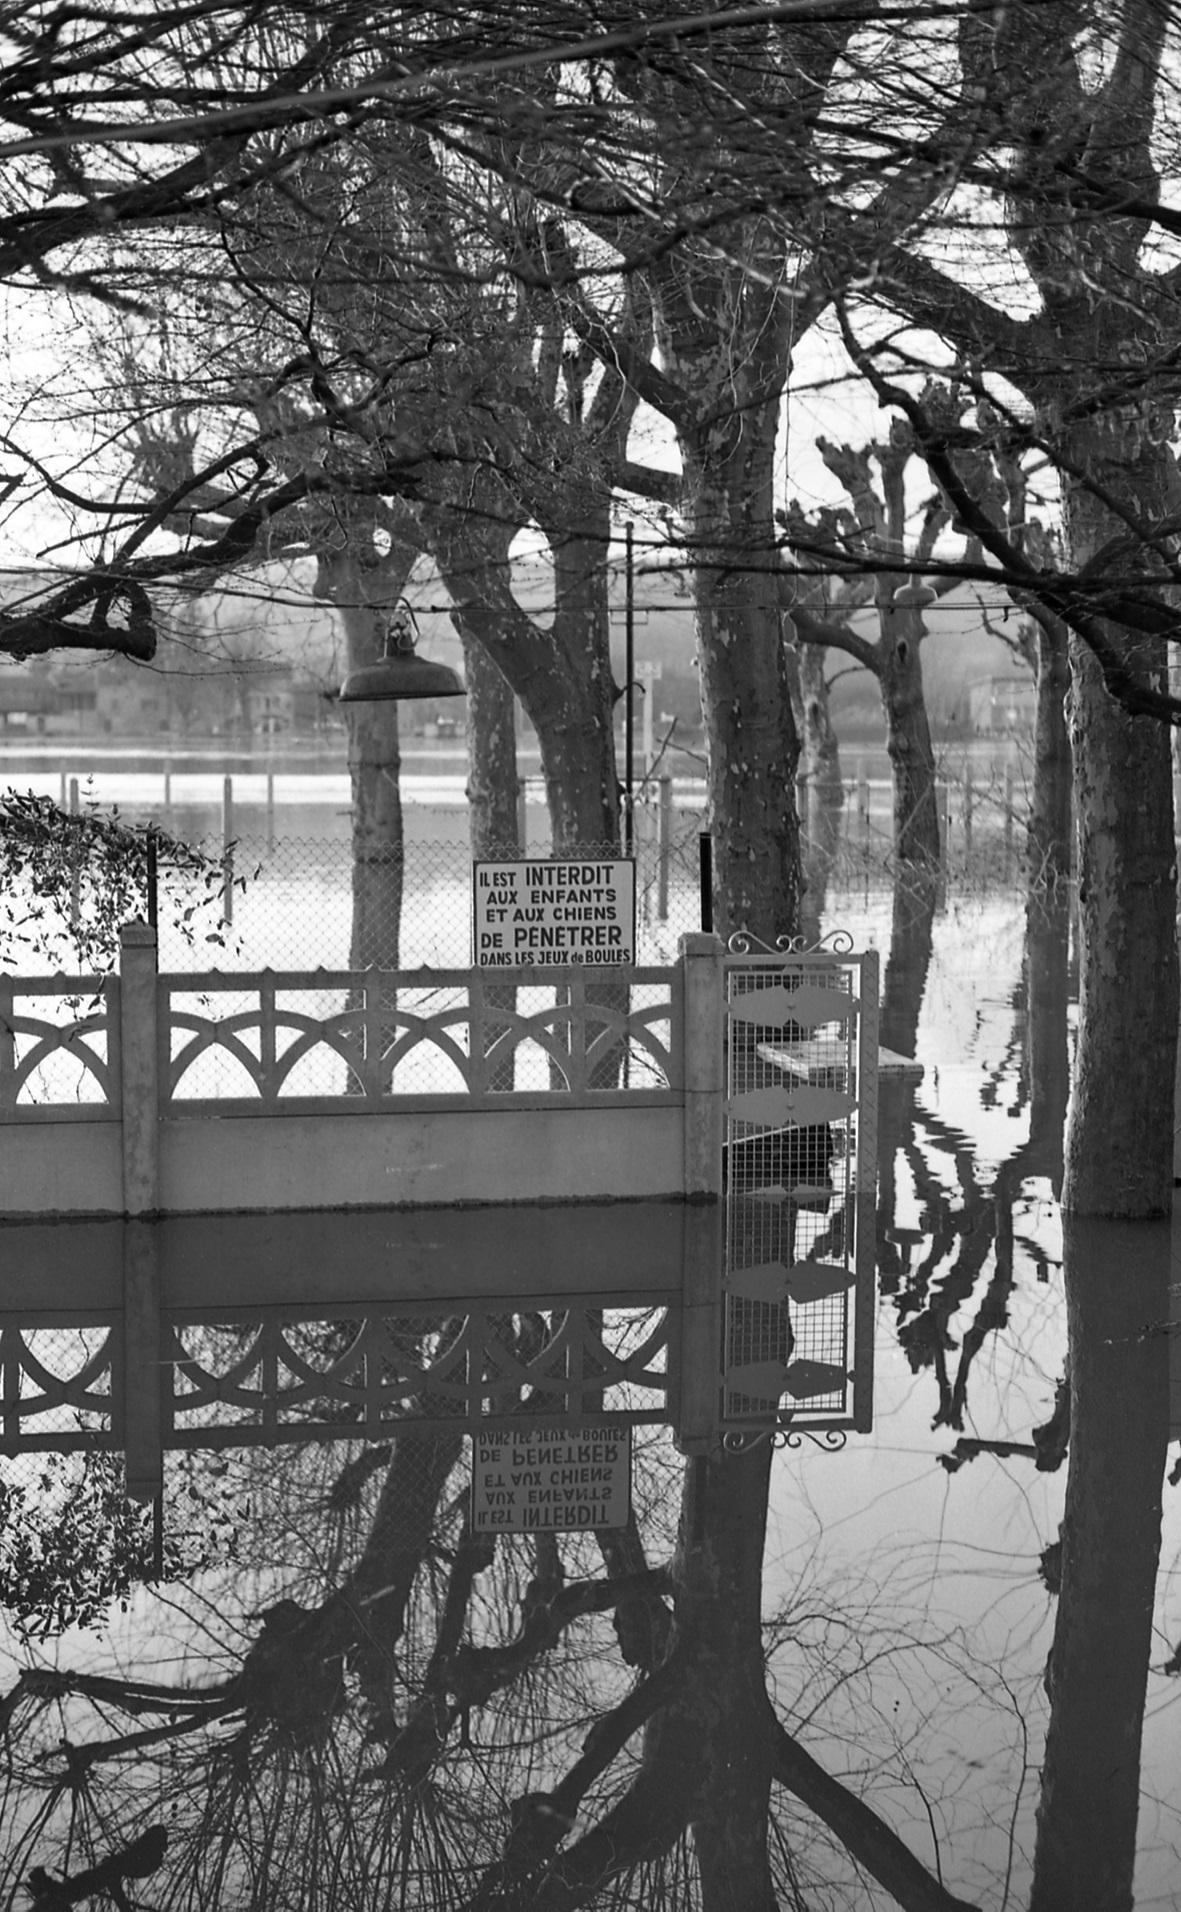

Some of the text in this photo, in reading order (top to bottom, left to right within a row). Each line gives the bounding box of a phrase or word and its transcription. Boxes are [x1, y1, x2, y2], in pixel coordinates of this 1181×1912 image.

[480, 866, 614, 887] IL EST INTERDIT
[487, 889, 616, 905] AUX ENFANTS
[486, 906, 616, 922] ET AUX CHIENS
[482, 933, 502, 948] DE
[480, 949, 630, 966] DANS LES JEUX de BOULES
